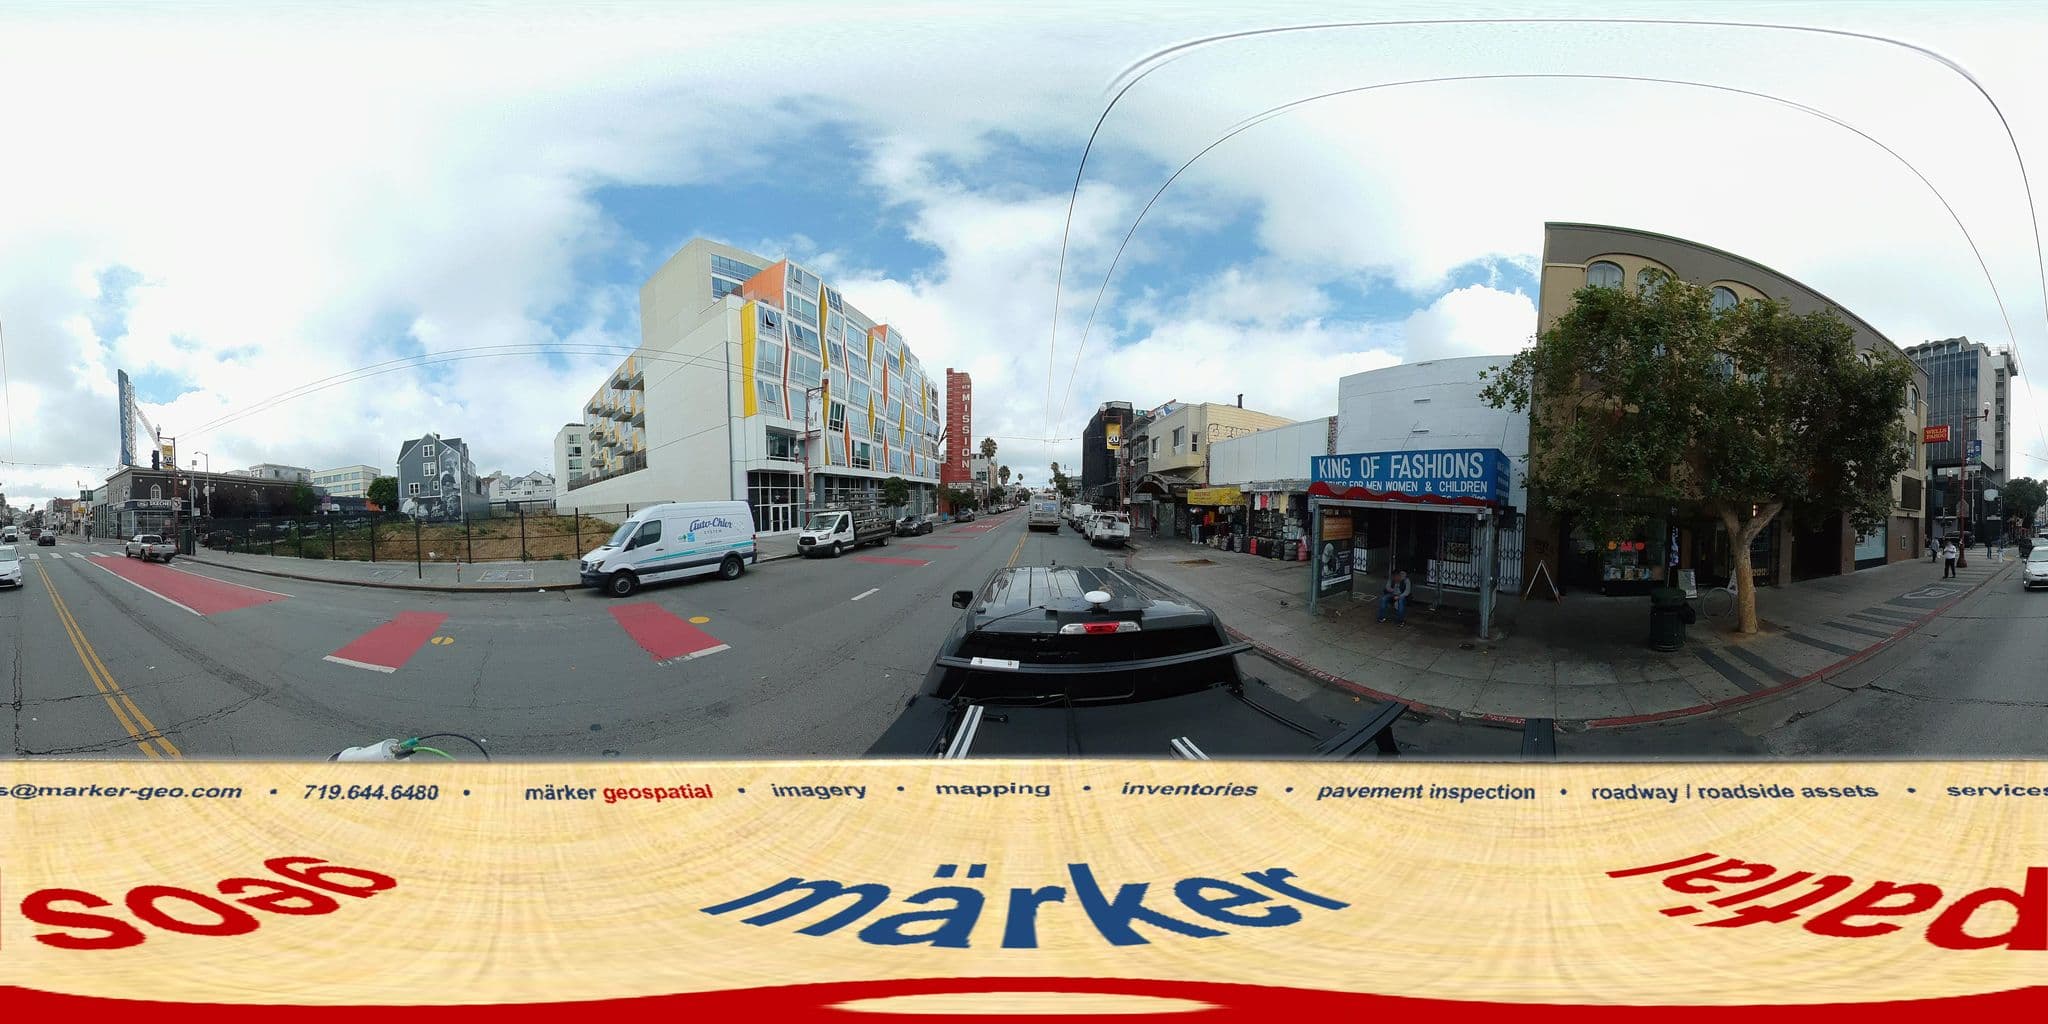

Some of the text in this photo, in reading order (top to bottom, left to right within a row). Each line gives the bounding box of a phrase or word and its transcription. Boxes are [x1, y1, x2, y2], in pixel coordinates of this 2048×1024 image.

[961, 393, 971, 469] MISSION
[1319, 458, 1351, 479] KING
[1360, 456, 1381, 479] OF
[1390, 452, 1483, 479] FASHIONS
[1366, 480, 1382, 492] MEN
[1385, 480, 1418, 492] WOMEN
[1425, 481, 1433, 492] &
[1439, 480, 1488, 493] CHILDREN
